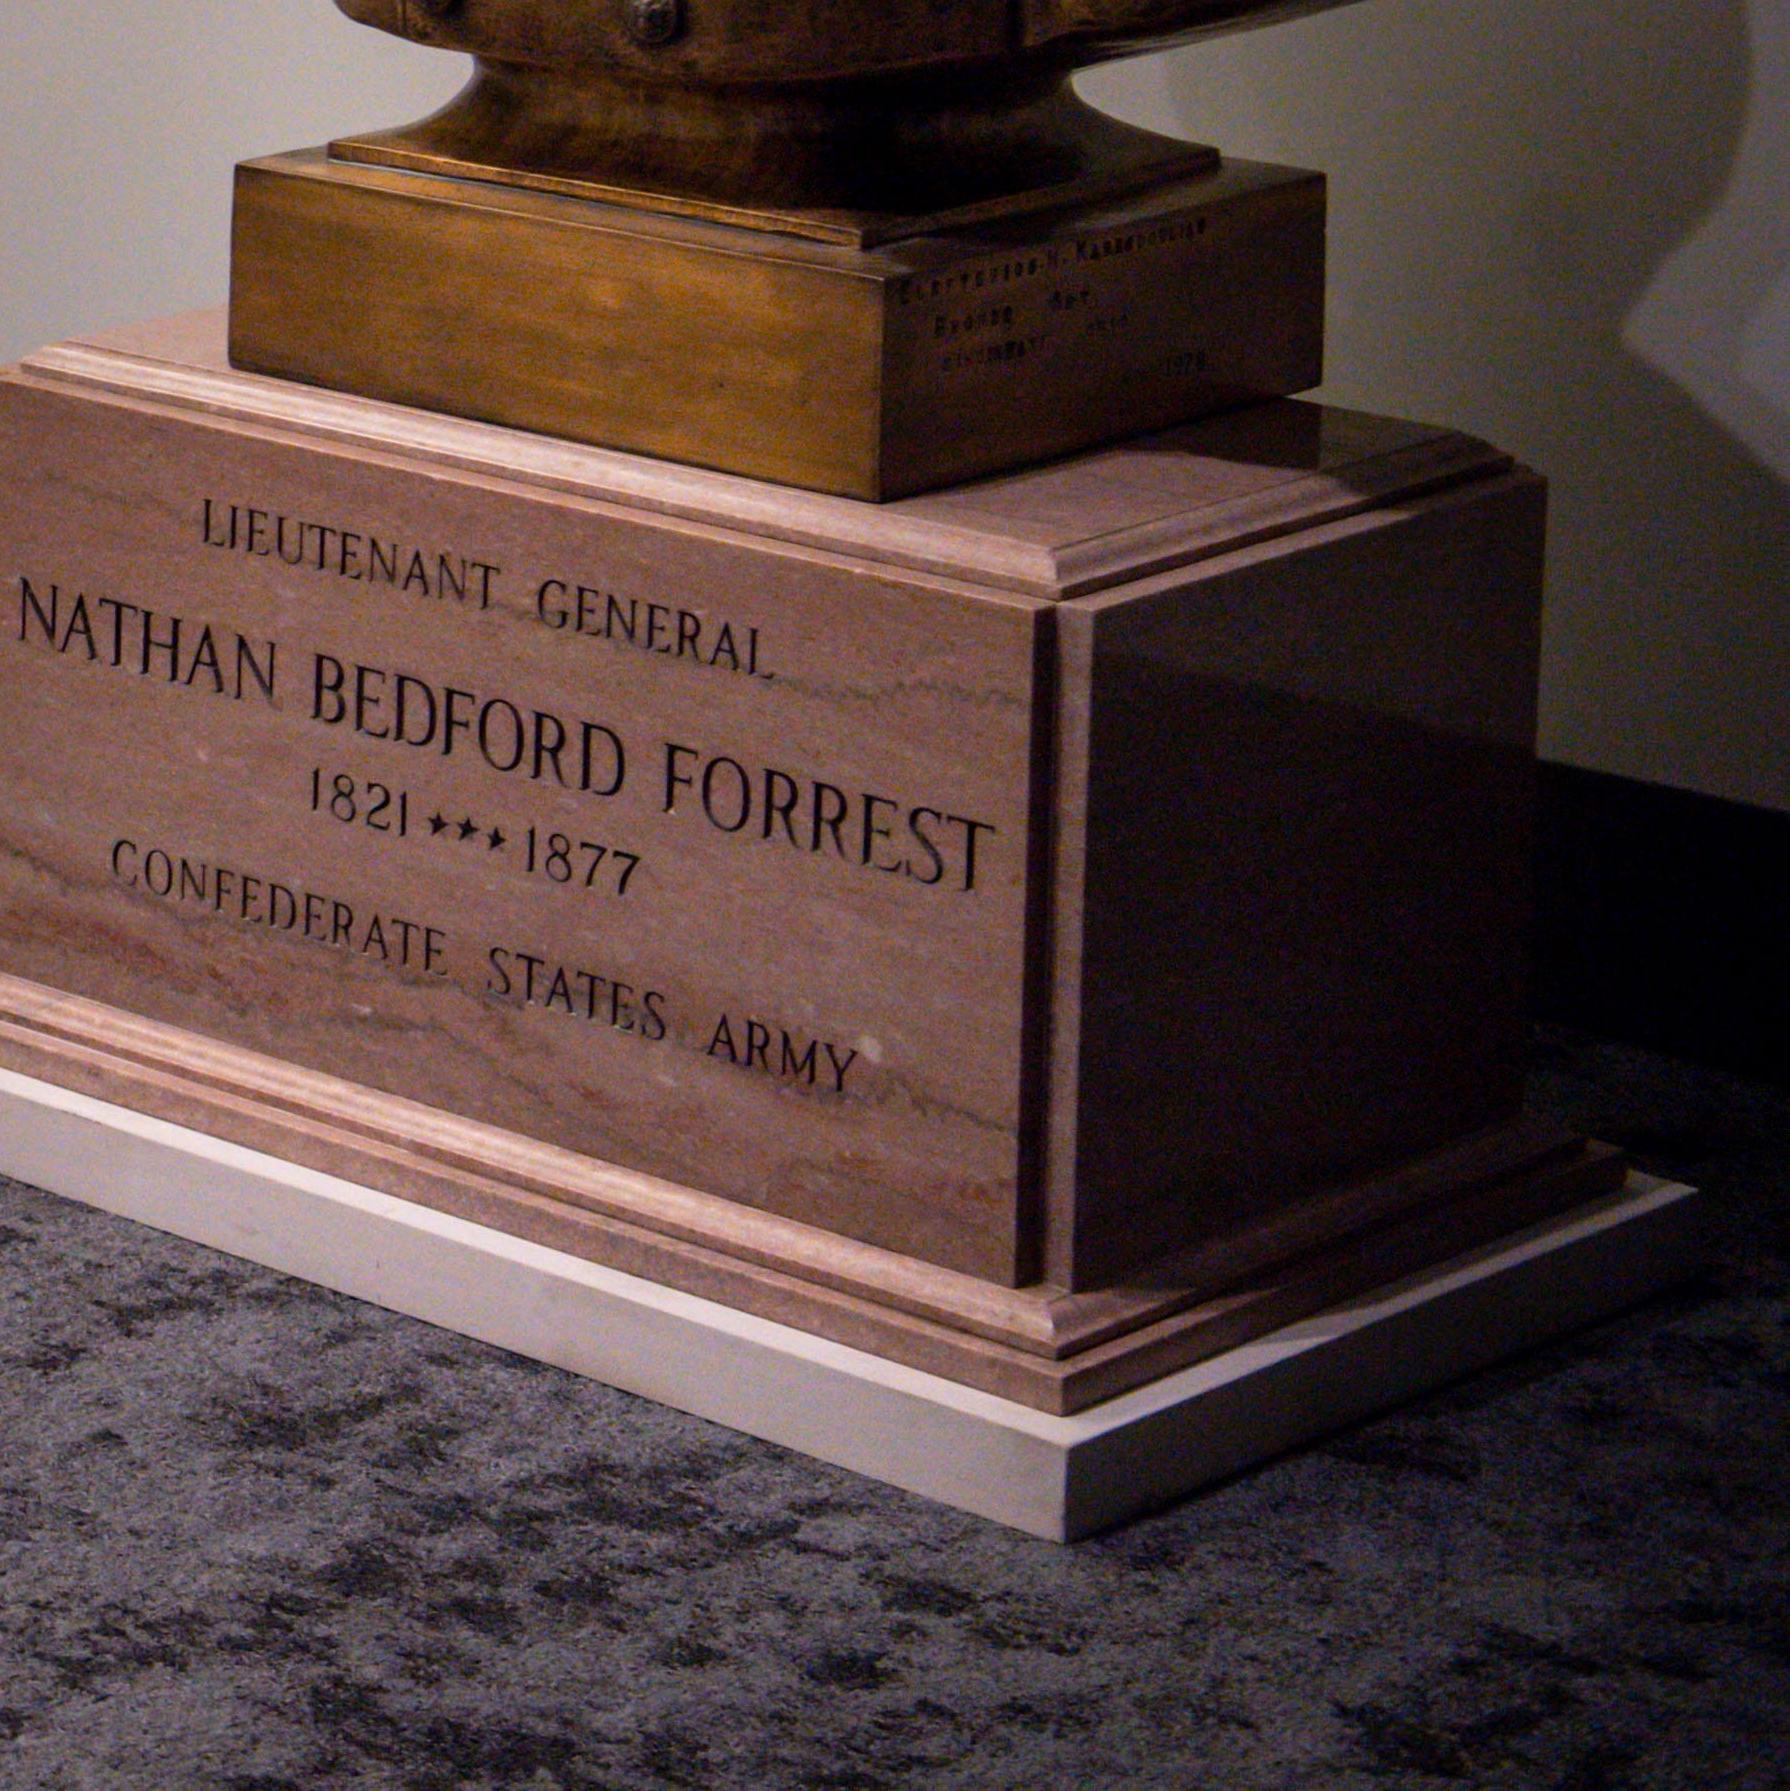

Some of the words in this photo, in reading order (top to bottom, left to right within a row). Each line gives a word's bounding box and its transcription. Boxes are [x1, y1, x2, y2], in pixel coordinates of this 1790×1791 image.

[200, 498, 501, 611] LIEUTENANT
[535, 577, 776, 681] GENERAL
[18, 575, 279, 701] NATHAN
[309, 652, 628, 797] BEDFORD
[661, 742, 997, 891] FORREST
[309, 767, 408, 837] 1821
[524, 825, 642, 896] 1877
[111, 838, 449, 978] CONFEDERATE
[486, 945, 667, 1043] STATES
[705, 1013, 859, 1093] ARMY
